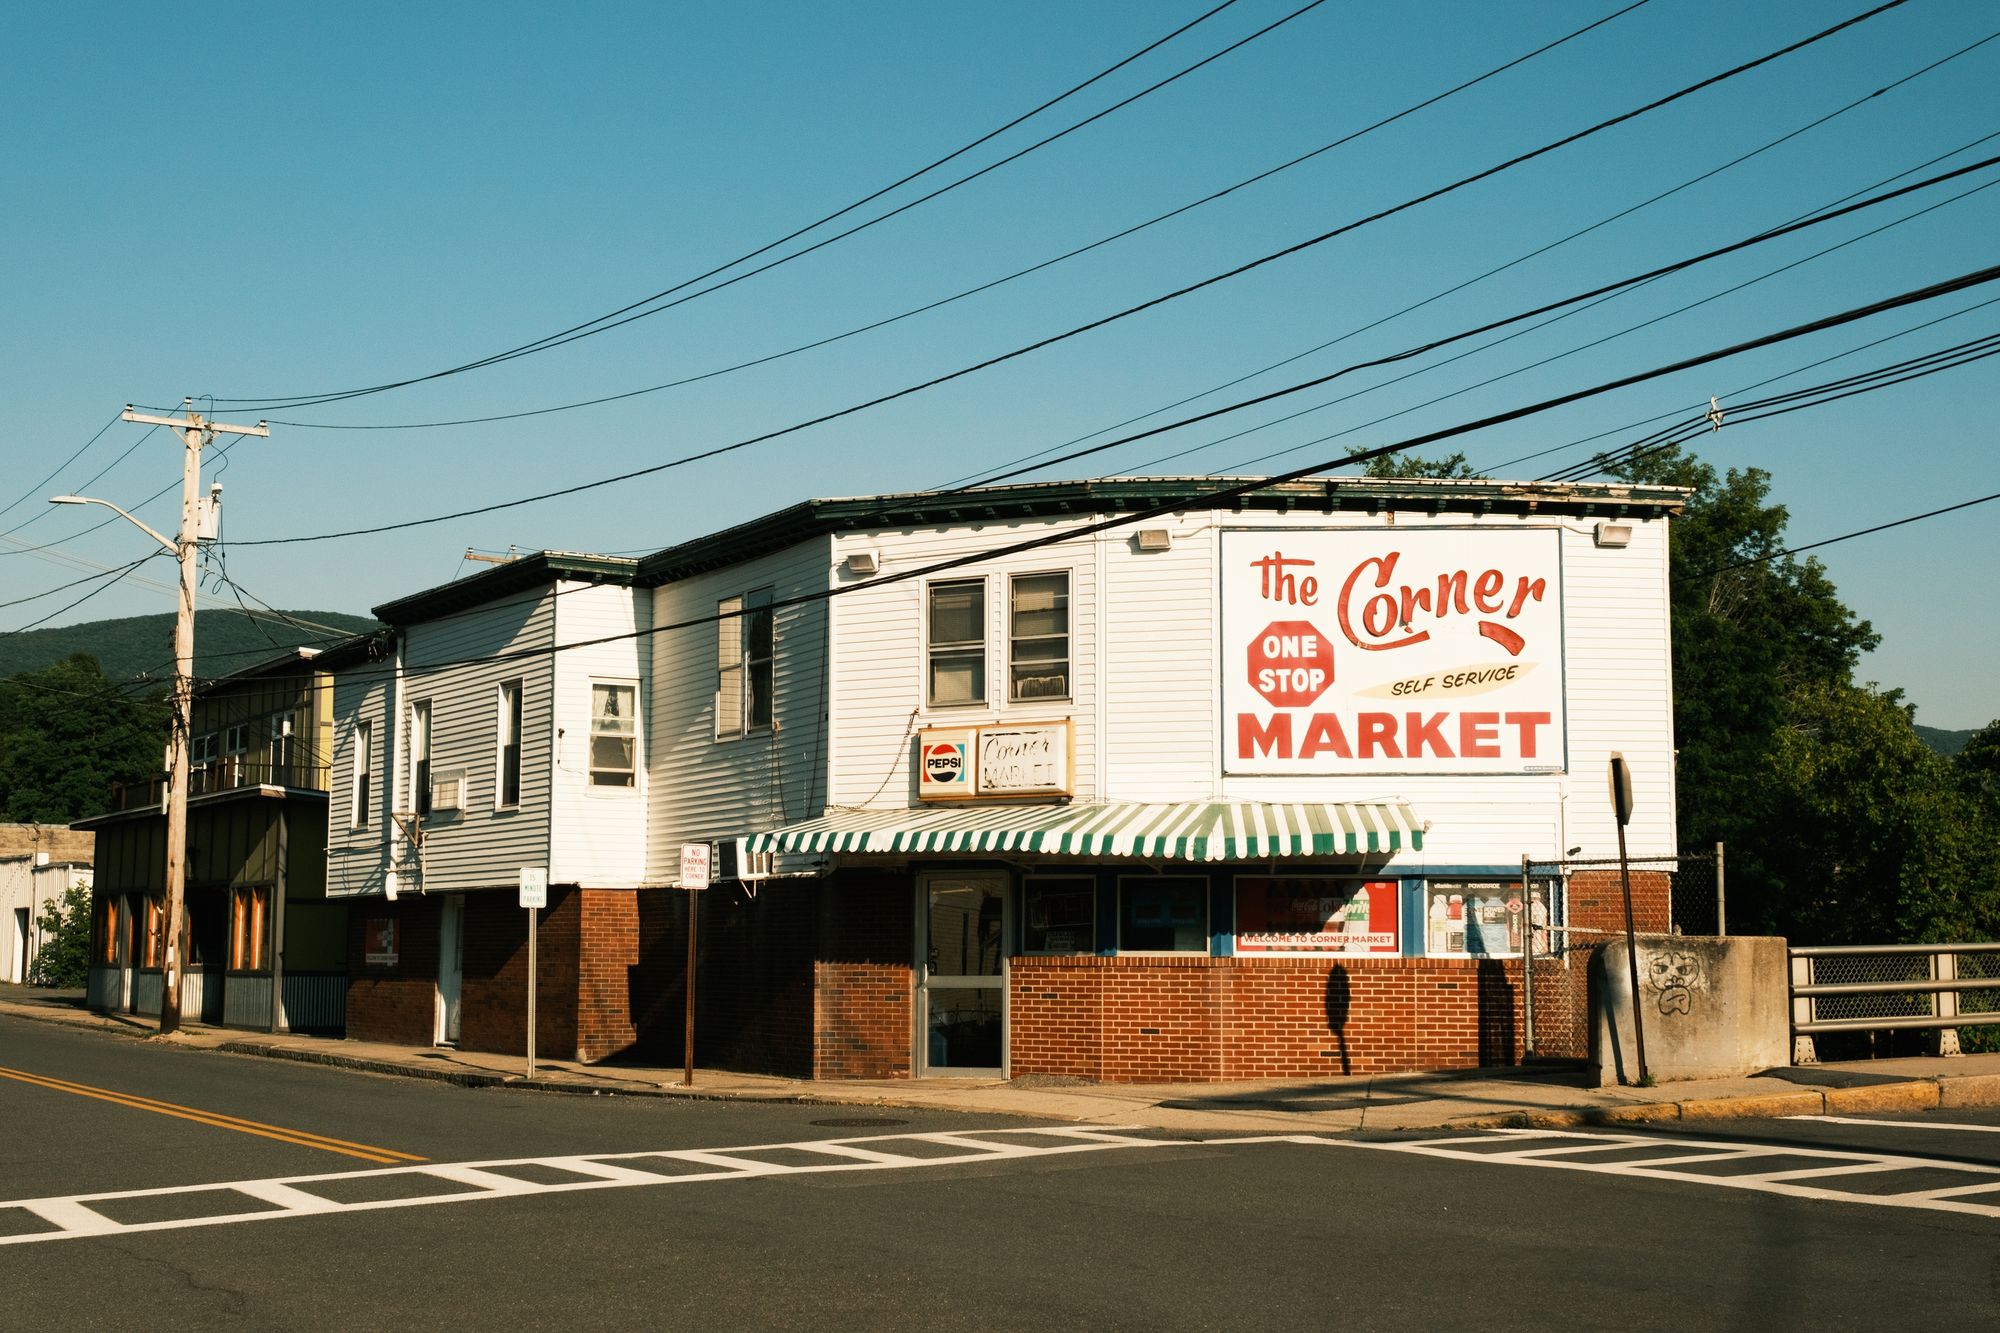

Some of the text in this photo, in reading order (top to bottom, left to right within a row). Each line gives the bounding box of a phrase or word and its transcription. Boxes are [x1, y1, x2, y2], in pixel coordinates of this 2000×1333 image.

[1250, 551, 1546, 651] The Corner
[1262, 635, 1318, 658] ONE
[1258, 668, 1326, 692] STOP
[1391, 665, 1519, 696] SELF SERVICE
[1237, 712, 1551, 759] MARKET
[927, 757, 961, 769] PEPSI
[683, 857, 707, 866] PARKING
[691, 849, 700, 857] NO
[1244, 935, 1392, 943] WELCOME TO CORNER MARKET
